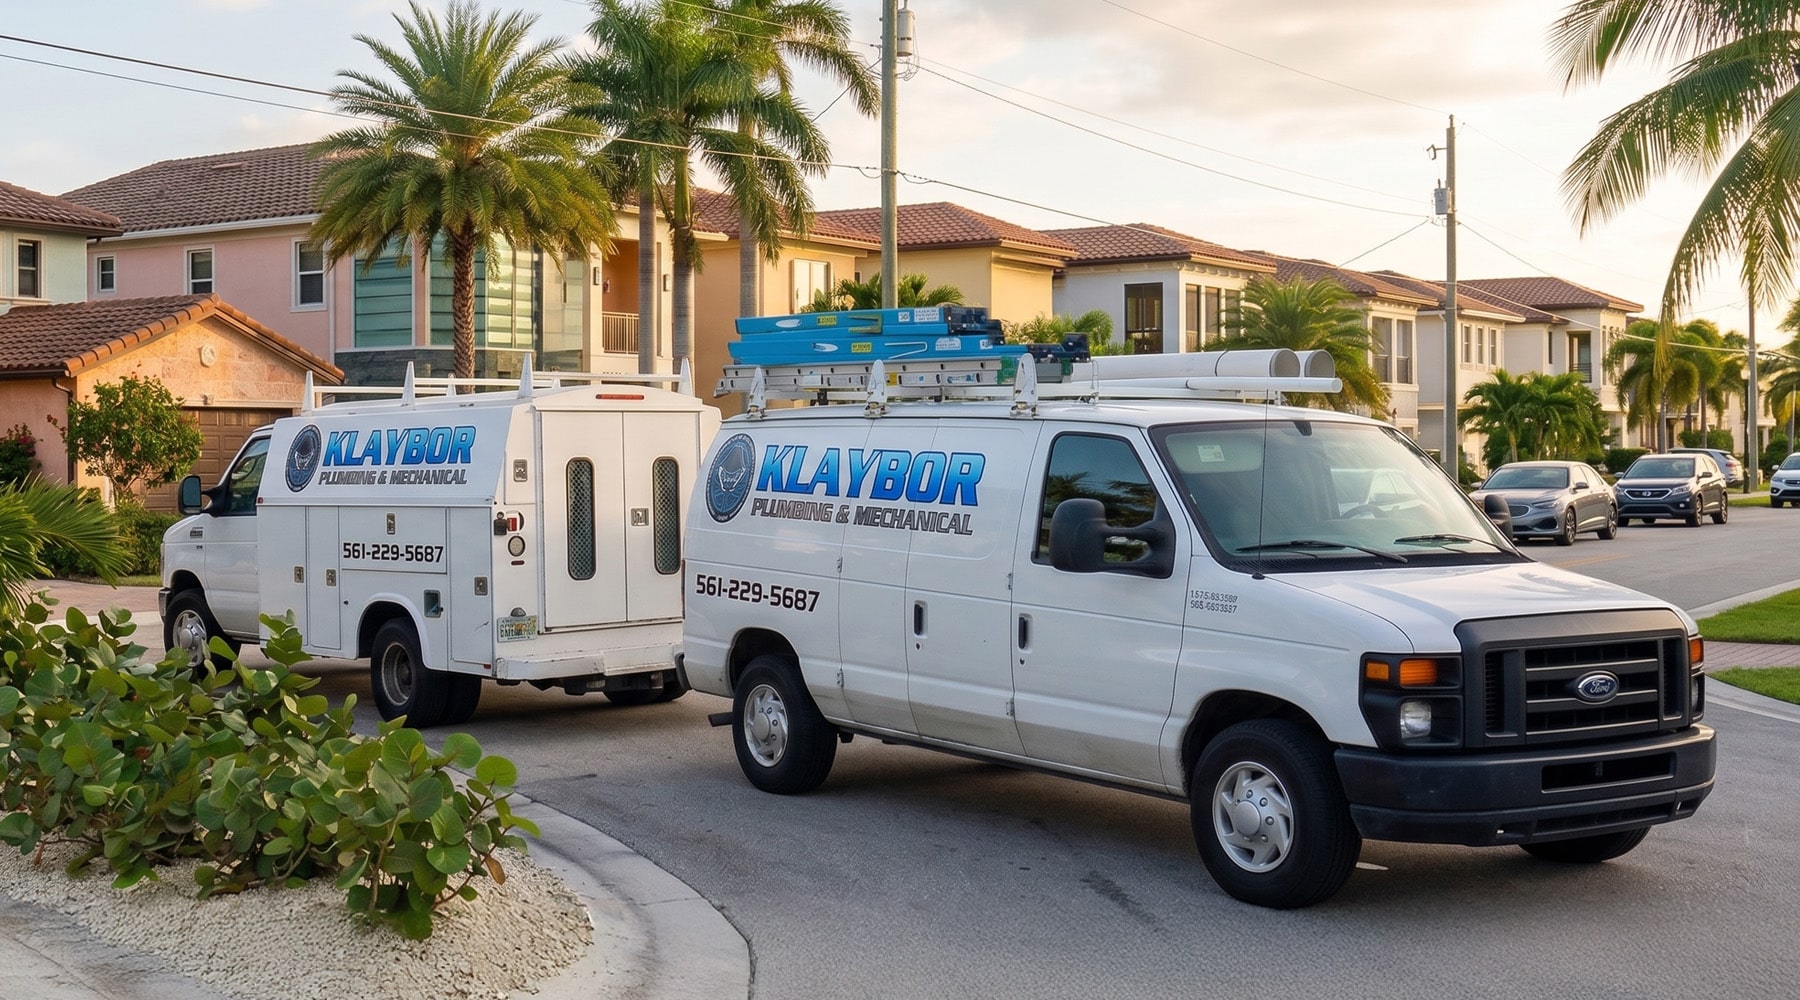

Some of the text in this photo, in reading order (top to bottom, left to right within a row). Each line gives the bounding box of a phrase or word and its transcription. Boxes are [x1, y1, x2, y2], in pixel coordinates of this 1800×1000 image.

[322, 426, 476, 466] KLAYBOR
[319, 469, 467, 485] PLUMBING & MECHANICAL
[756, 445, 985, 506] KLAYBOR
[751, 498, 973, 535] PLUMBING & MECHANICAL
[343, 542, 443, 563] 561-229-5687
[696, 574, 820, 612] 561-229-5687
[1590, 680, 1610, 693] Ford
